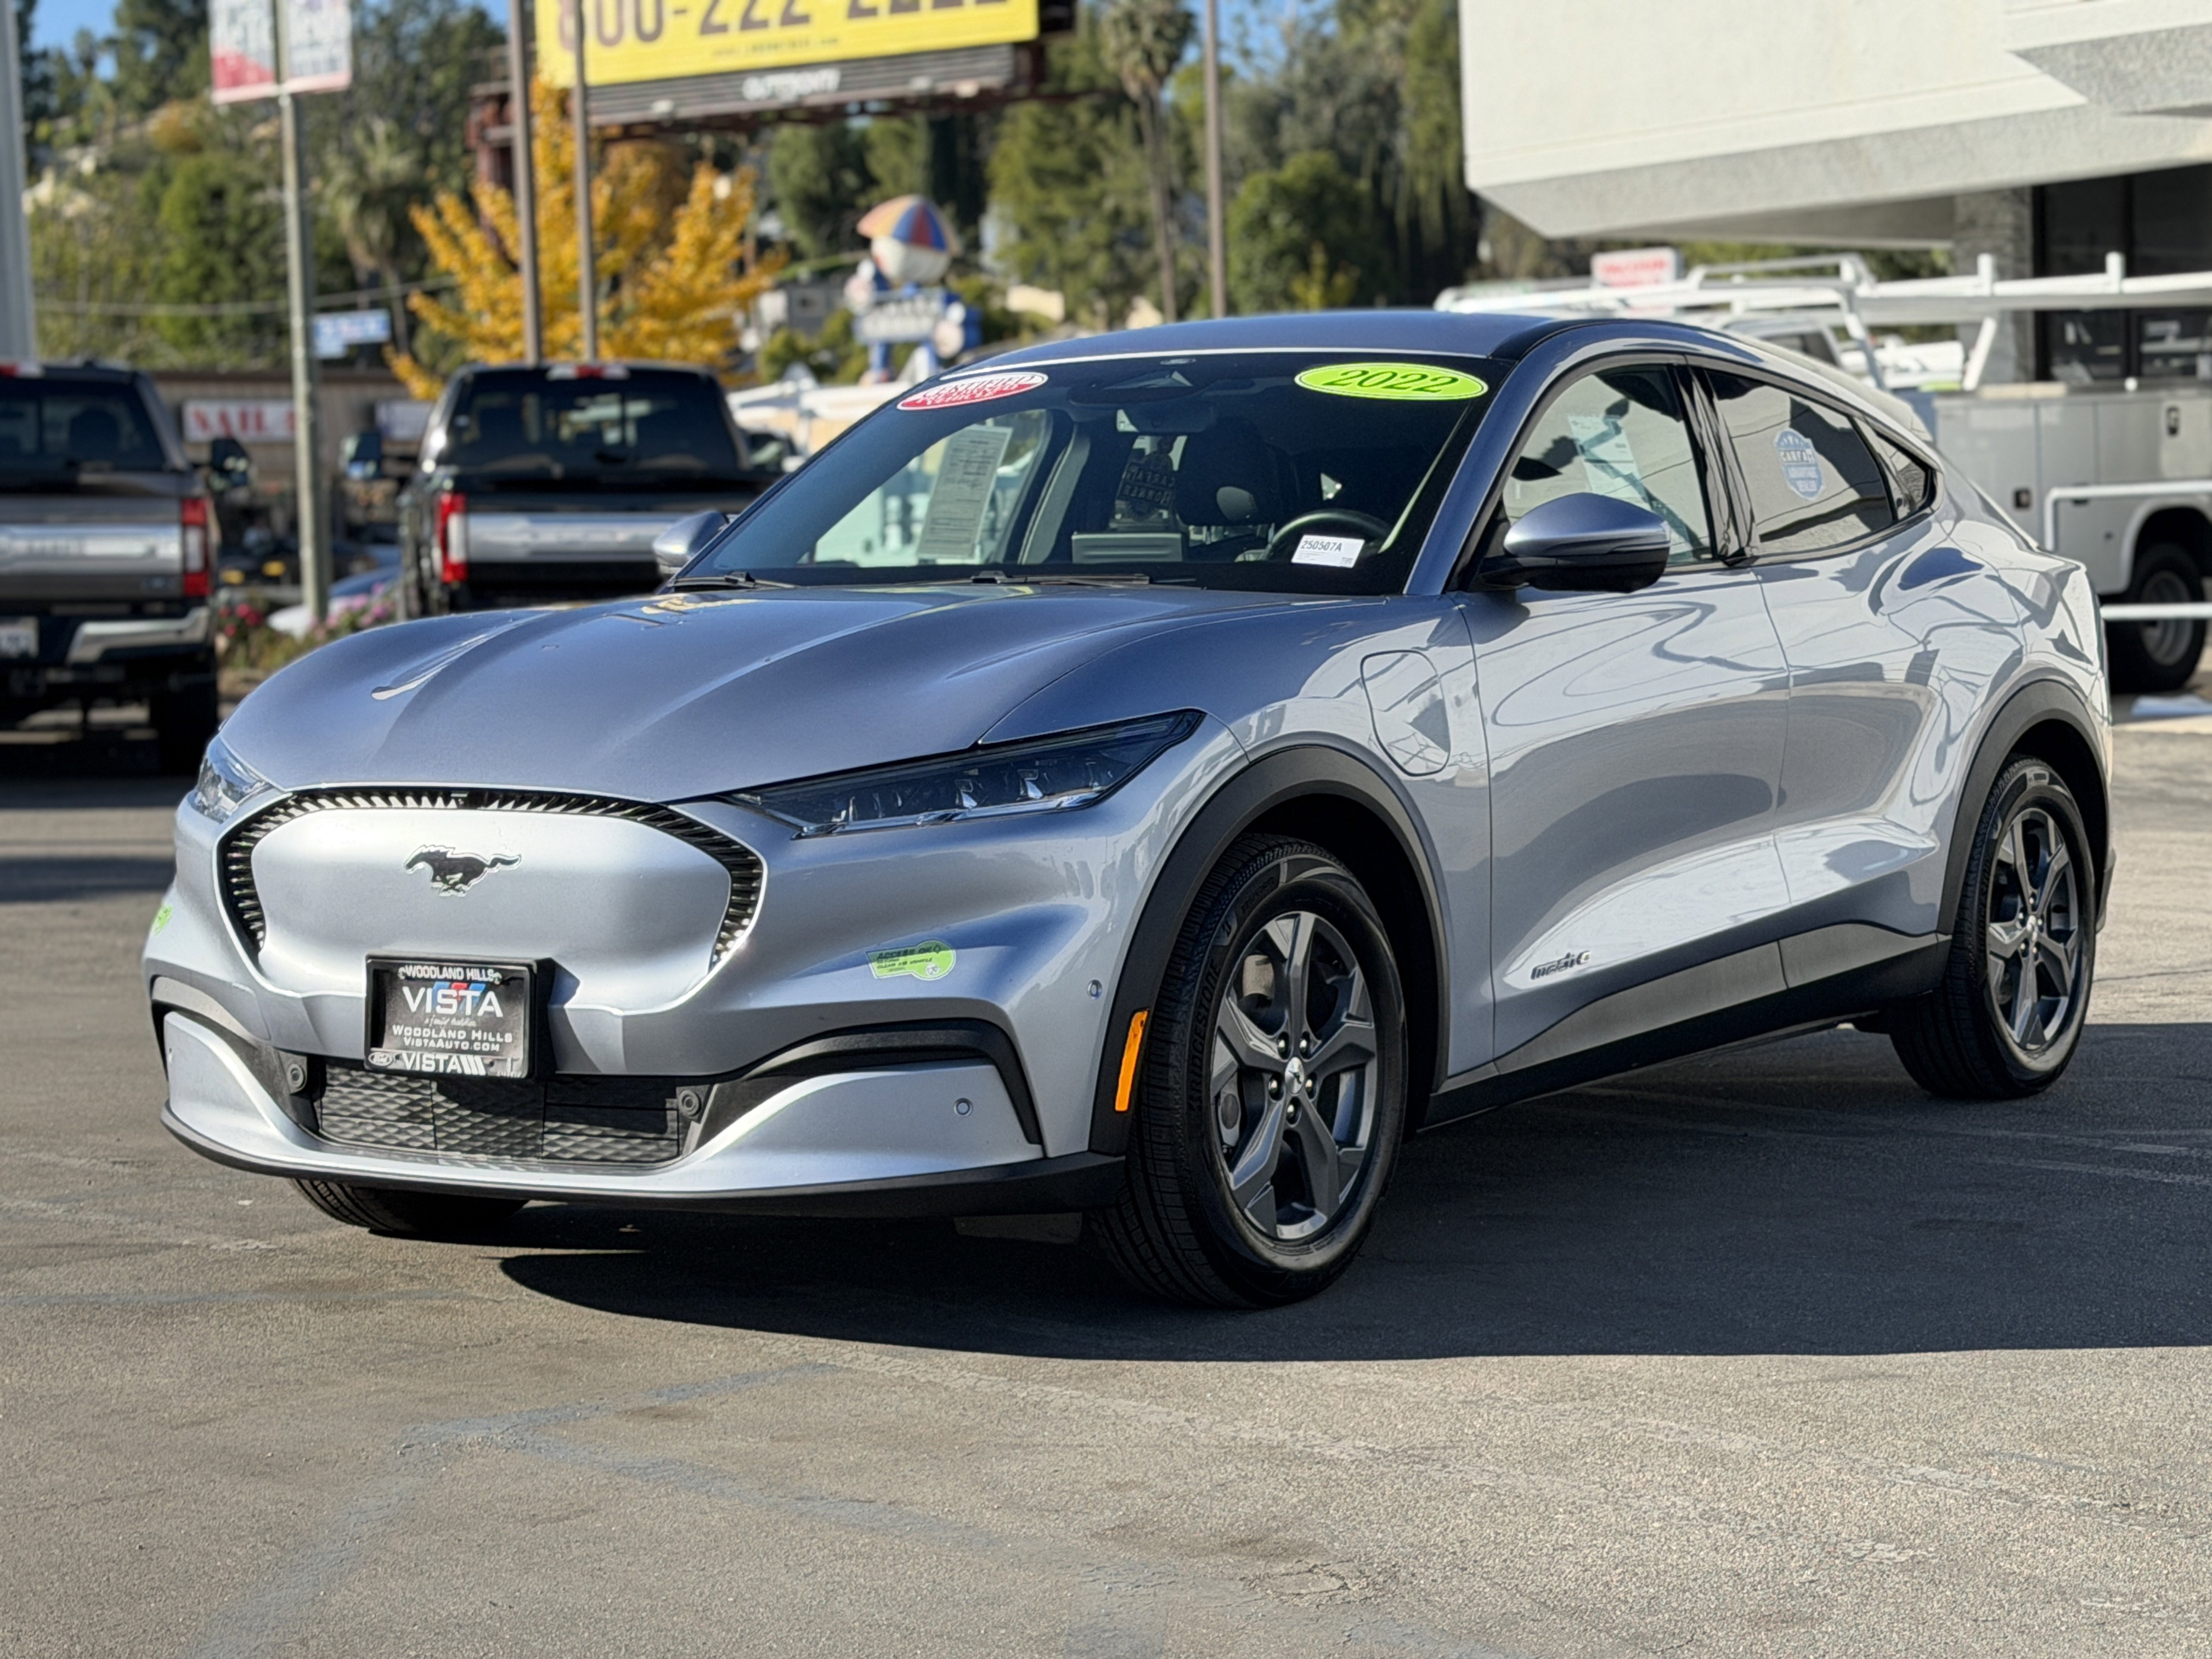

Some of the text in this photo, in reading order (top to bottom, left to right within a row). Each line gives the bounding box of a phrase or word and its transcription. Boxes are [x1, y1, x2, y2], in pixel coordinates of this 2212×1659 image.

[1322, 369, 1459, 393] 2022
[1300, 540, 1342, 552] 250507A
[404, 964, 494, 982] WOODLAND HILLS
[402, 986, 504, 1018] VISTA
[392, 1024, 513, 1043] WOODLAND HILLS
[402, 1052, 462, 1074] VISTA
